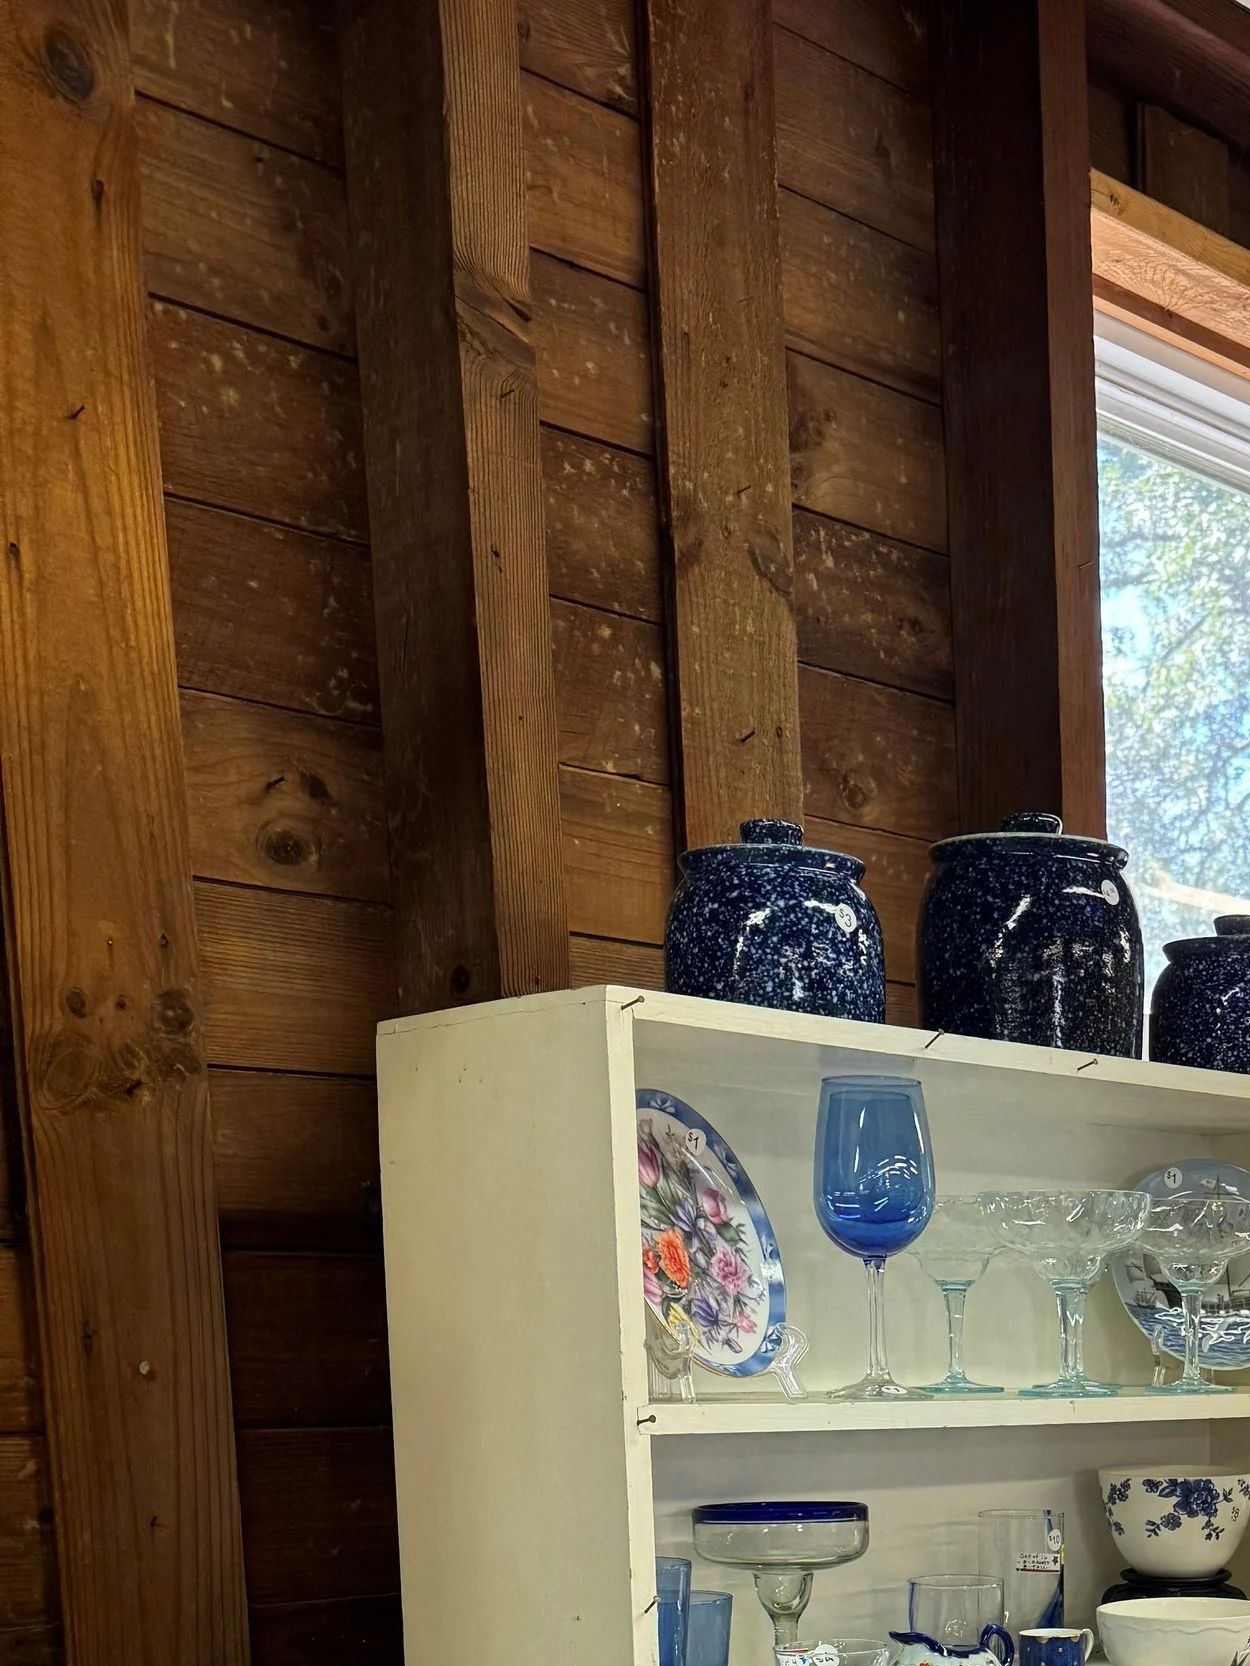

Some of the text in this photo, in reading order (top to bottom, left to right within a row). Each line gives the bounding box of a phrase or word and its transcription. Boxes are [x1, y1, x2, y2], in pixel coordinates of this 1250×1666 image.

[839, 907, 853, 928] $3
[687, 1131, 700, 1147] $1
[1165, 1170, 1176, 1184] $1
[1048, 1534, 1060, 1545] $10
